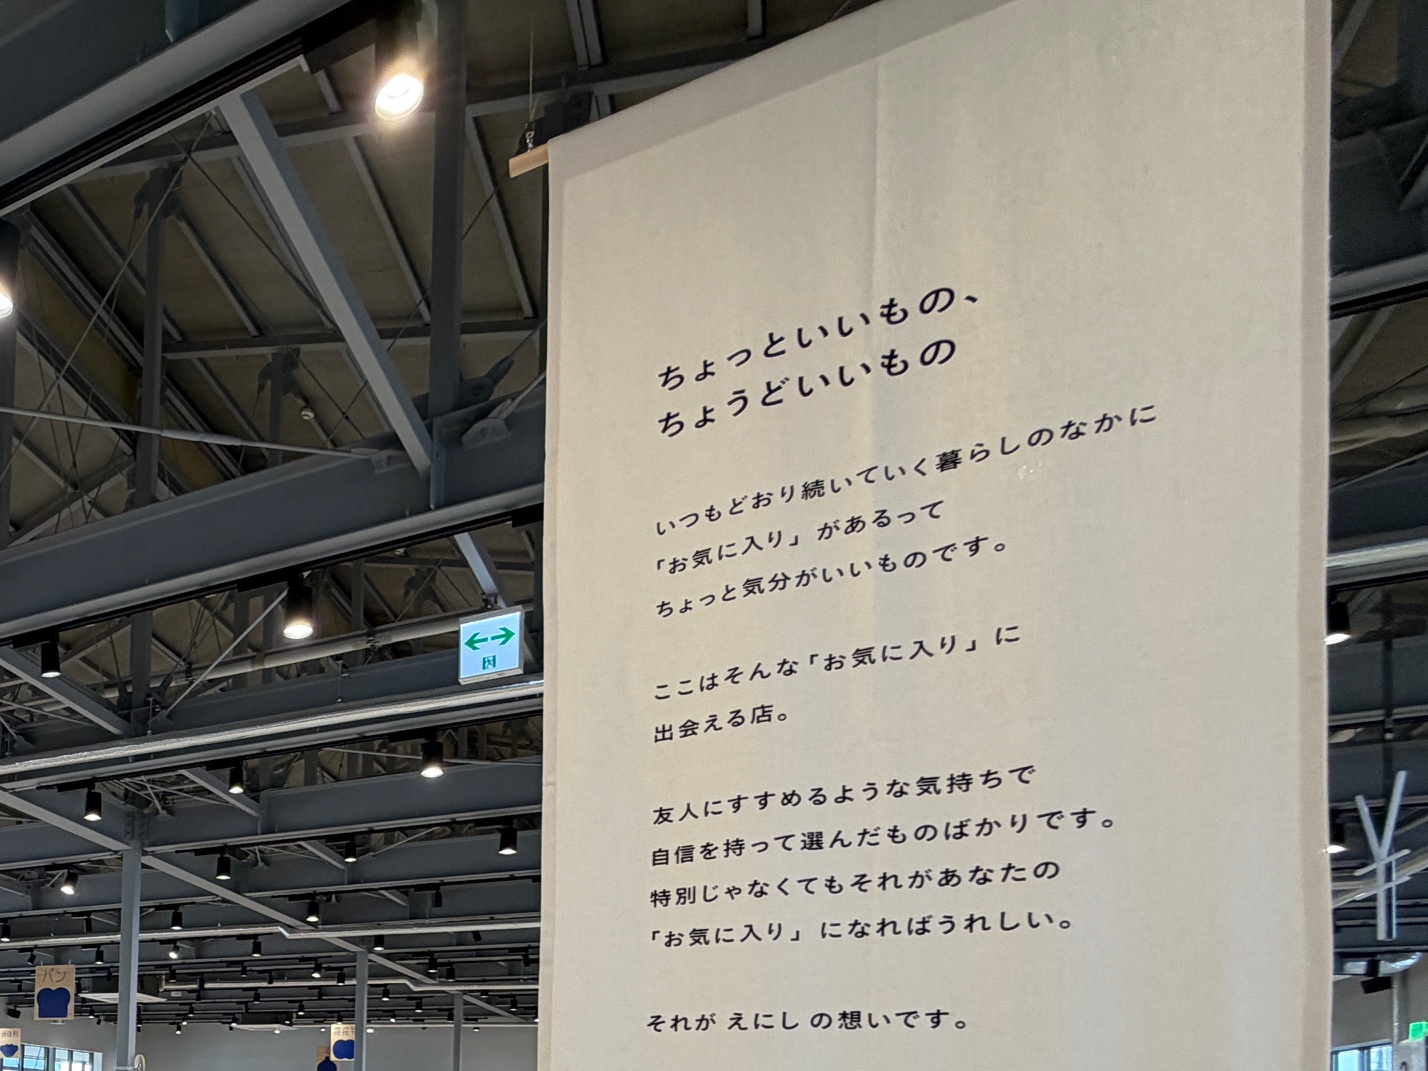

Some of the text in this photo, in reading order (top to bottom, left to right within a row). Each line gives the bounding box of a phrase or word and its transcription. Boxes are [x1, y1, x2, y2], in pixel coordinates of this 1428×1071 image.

[656, 286, 980, 392] ちょっといいもの、
[656, 338, 958, 439] ちょうどいいもの
[655, 404, 1158, 537] いつもどおり続いていく暮らしのなかに
[656, 499, 946, 576] 「お気に入り」があるって
[655, 534, 1008, 619] ちょっと気分がいいものです。
[653, 624, 1022, 701] ここはそんな「お気に入り」に
[653, 703, 789, 745] 出会える店。
[652, 764, 1038, 826] 友人にすすめるような気持ちで
[651, 806, 1115, 868] 自信を持って選んだものばかりです。
[649, 860, 1062, 909] 特別じゃなくてもそれがあなたの
[650, 910, 1073, 949] 「お気に入り」になればうれしい。
[42, 968, 67, 983] パン
